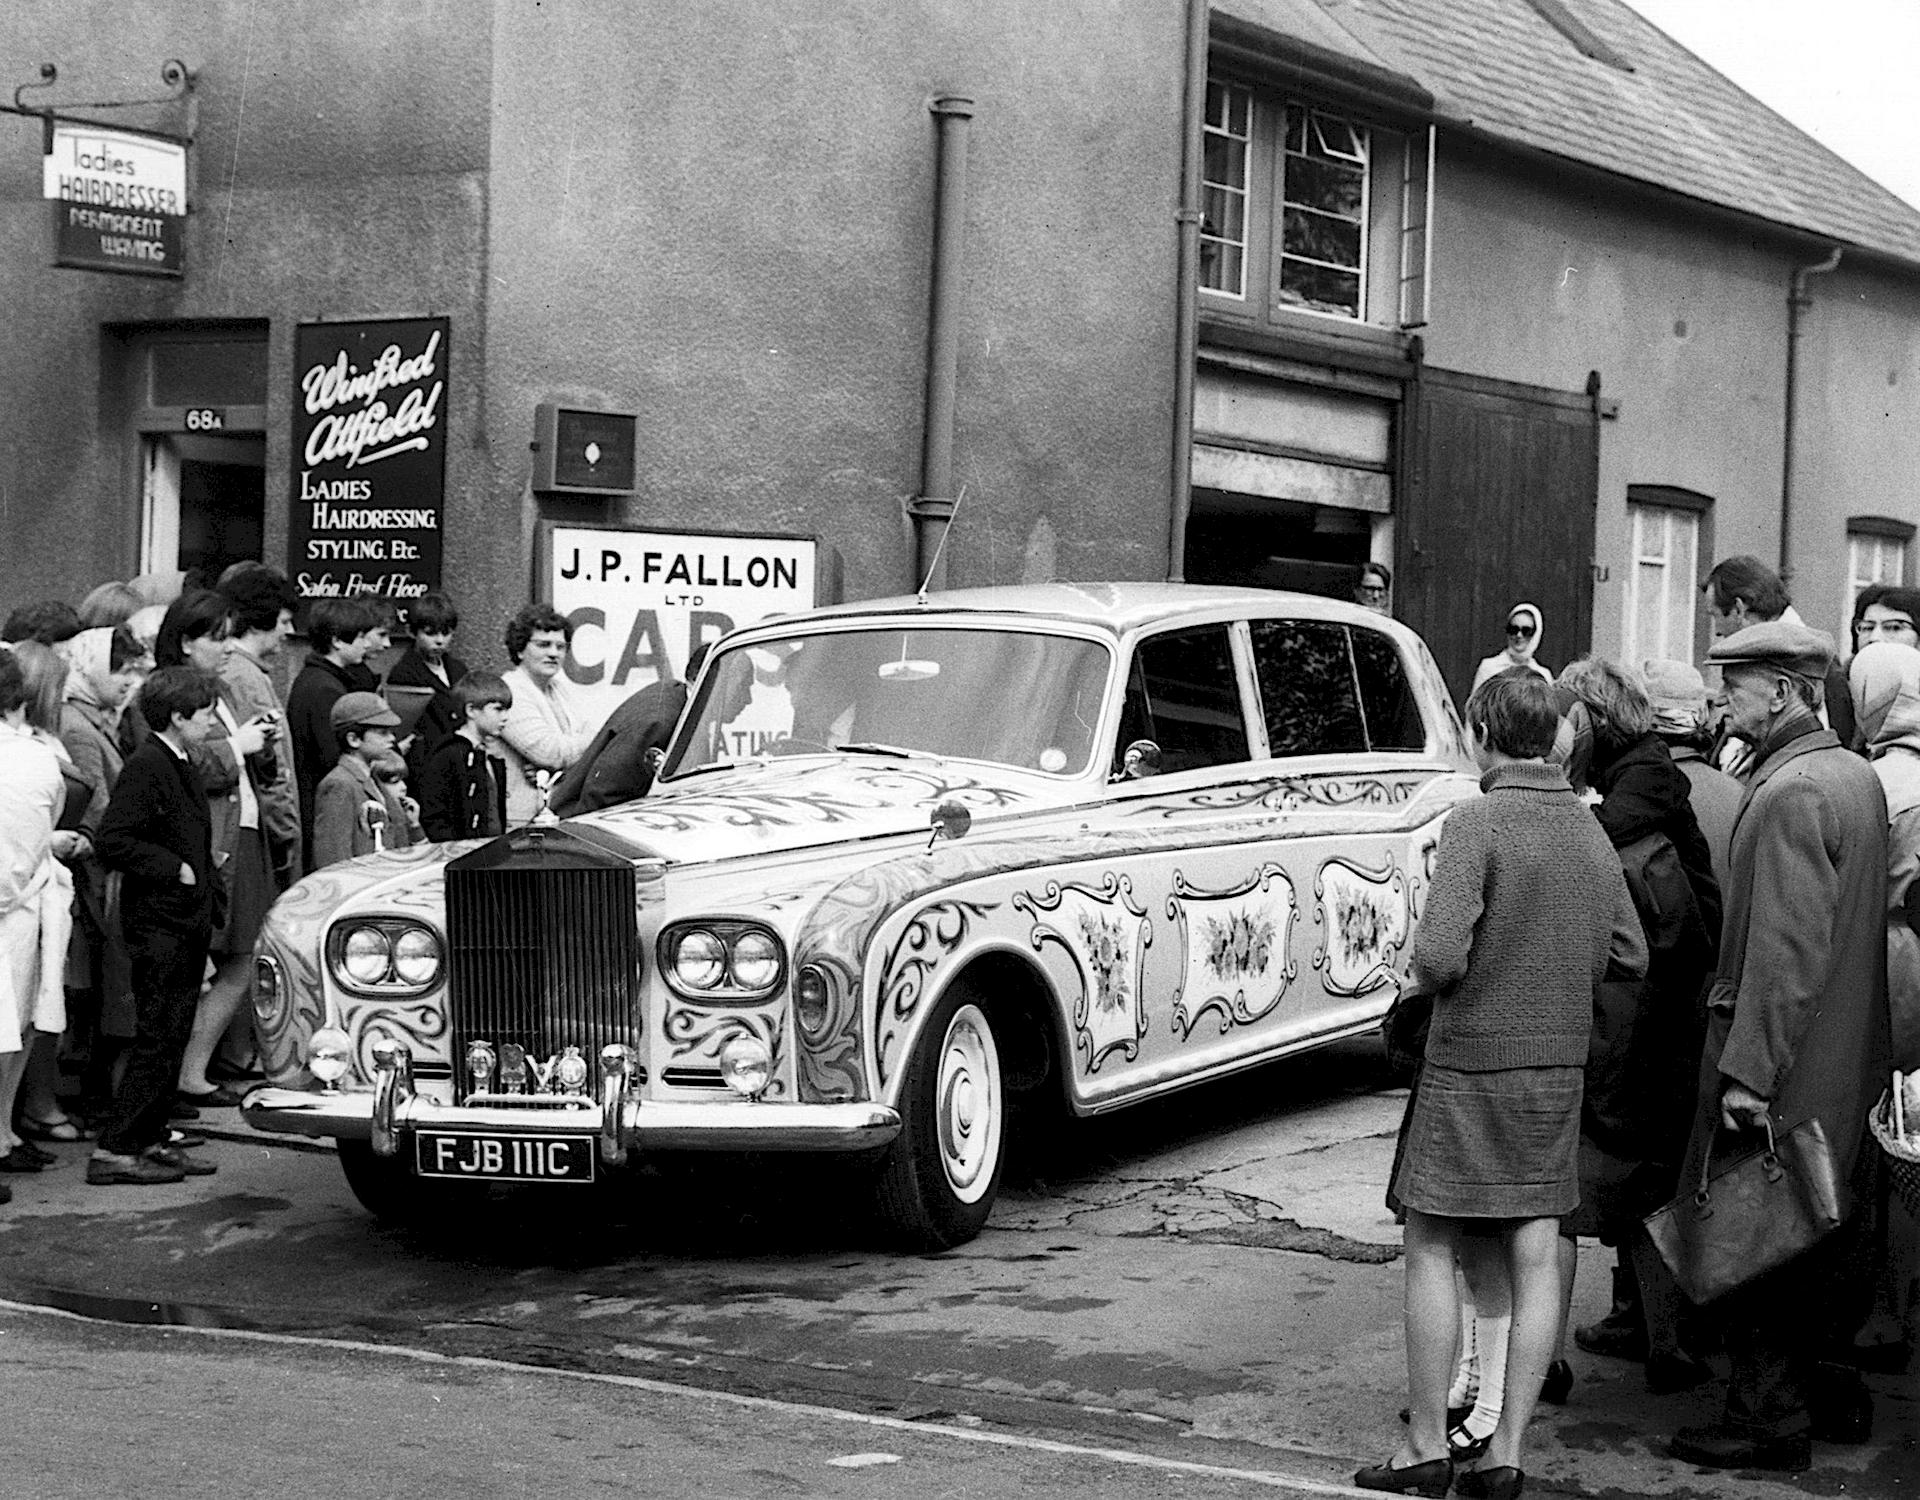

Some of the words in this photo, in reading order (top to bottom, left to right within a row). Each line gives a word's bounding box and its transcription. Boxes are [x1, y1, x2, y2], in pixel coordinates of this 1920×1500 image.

[59, 174, 180, 214] HAIRDRESSER
[300, 470, 372, 500] LADIES
[643, 552, 797, 589] FALLON
[665, 595, 704, 606] LTD
[436, 1138, 503, 1173] FJB
